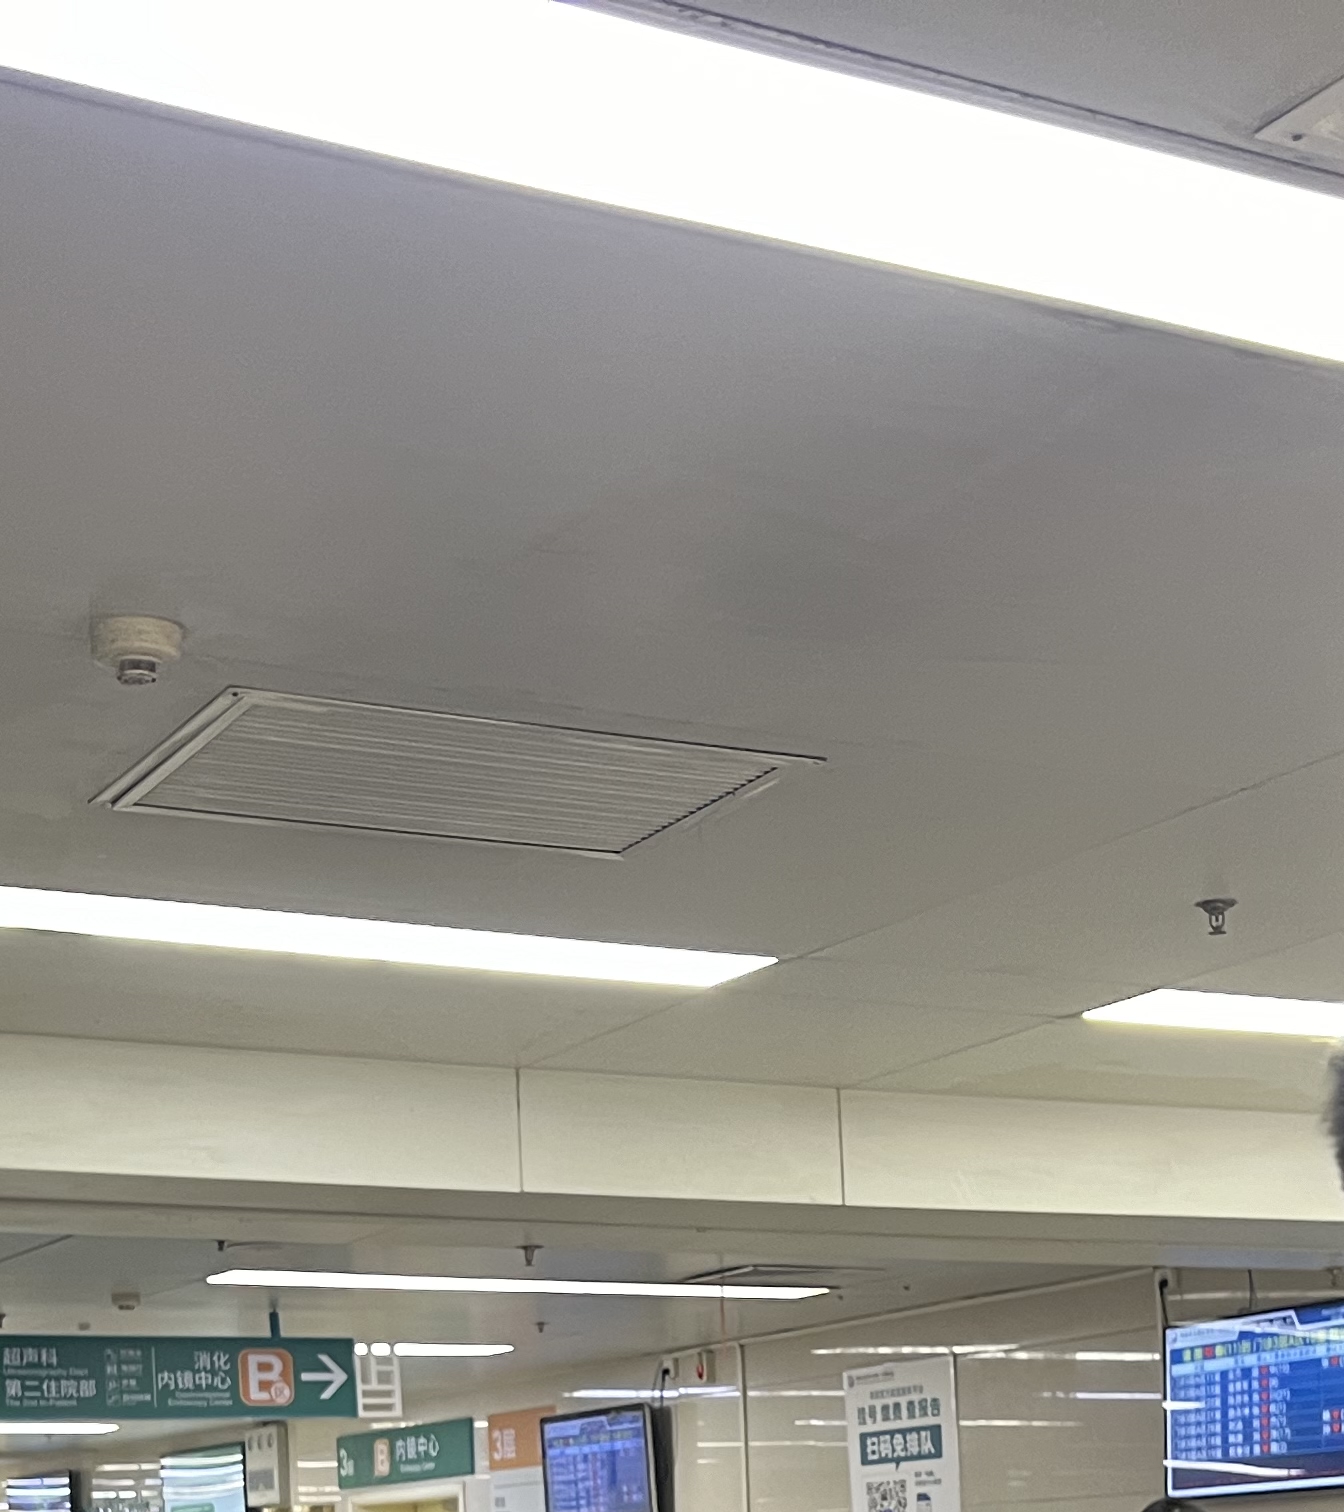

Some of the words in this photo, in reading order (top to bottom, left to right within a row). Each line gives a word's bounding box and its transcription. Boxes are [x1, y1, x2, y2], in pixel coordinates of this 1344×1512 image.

[194, 1350, 230, 1371] 消化
[6, 1379, 96, 1397] 第二住院部
[157, 1370, 232, 1390] 内镜中心
[395, 1433, 439, 1462] 内镜中心
[866, 1430, 935, 1460] 扫码免排队
